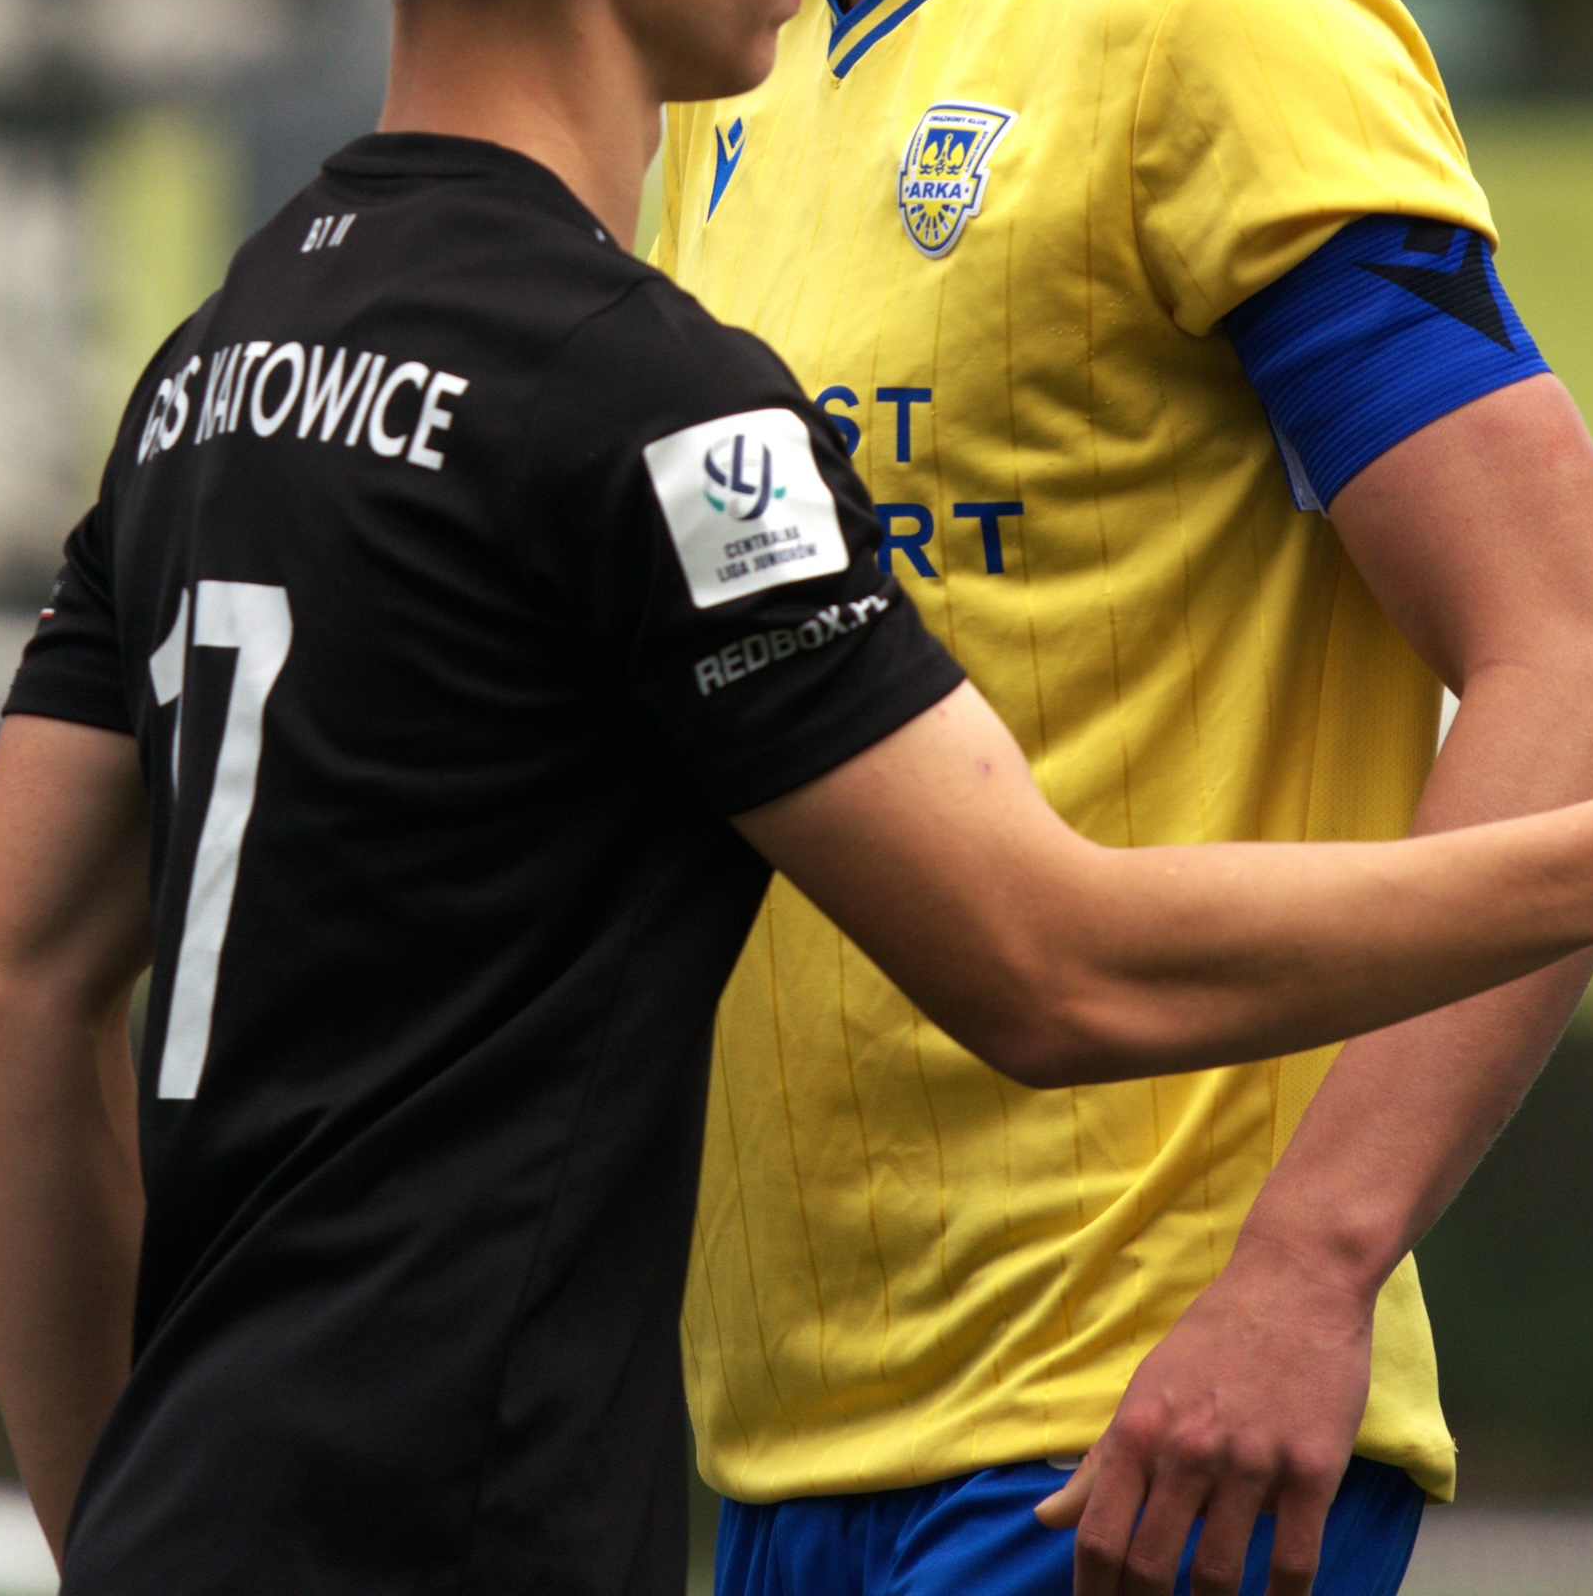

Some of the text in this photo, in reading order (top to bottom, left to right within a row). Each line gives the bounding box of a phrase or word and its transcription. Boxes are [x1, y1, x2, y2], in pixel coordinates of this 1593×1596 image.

[908, 181, 962, 199] ARKA
[194, 340, 470, 471] KATOWICE
[717, 559, 750, 583] LIGA
